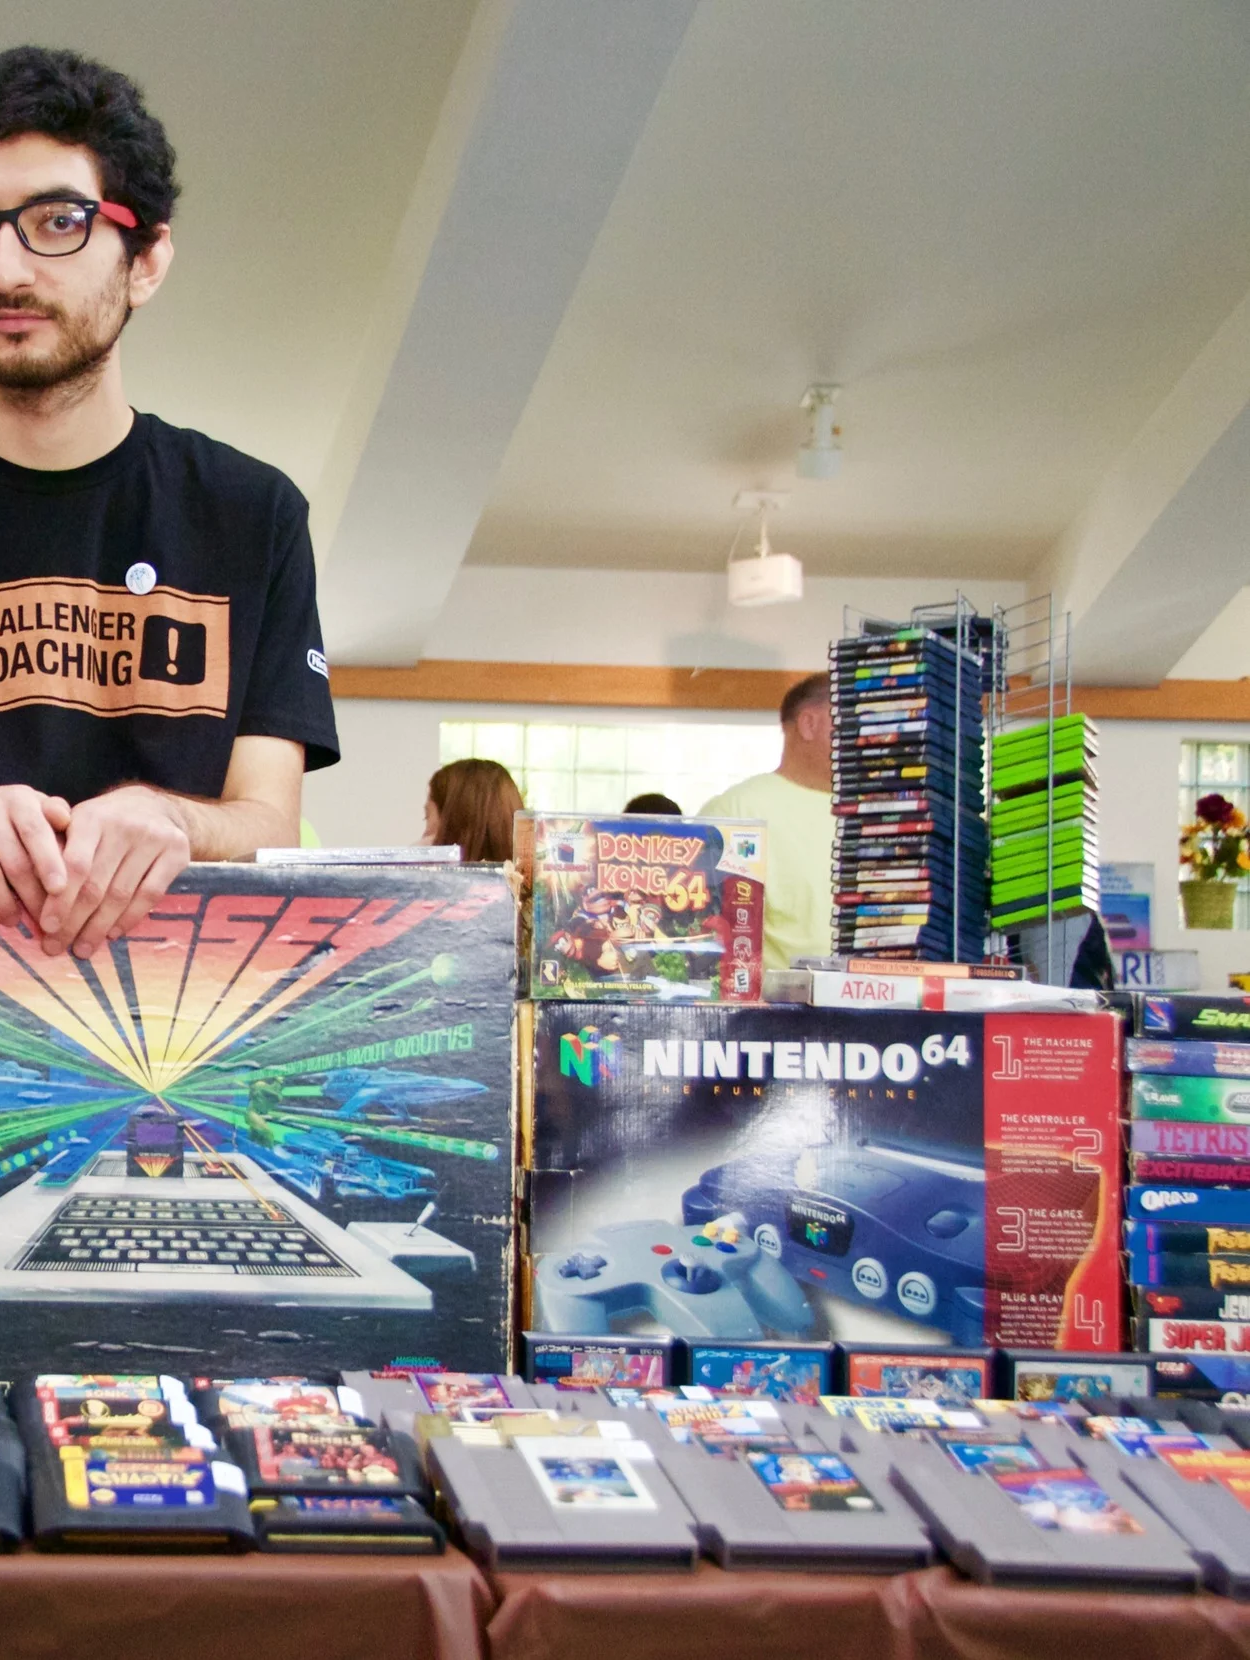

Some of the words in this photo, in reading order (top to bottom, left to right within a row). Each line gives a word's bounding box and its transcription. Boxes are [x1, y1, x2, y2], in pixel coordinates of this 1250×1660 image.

[597, 832, 705, 867] DONKEY
[597, 863, 668, 895] KONG
[664, 871, 708, 912] 64
[1117, 952, 1151, 985] RI
[840, 980, 895, 1001] ATARI
[643, 1039, 919, 1081] NINTENDO
[921, 1034, 970, 1066] 64
[992, 1035, 1021, 1080] 1
[1023, 1037, 1042, 1047] THE
[1045, 1038, 1093, 1048] MACHINE
[714, 1085, 762, 1097] FUN
[786, 1086, 916, 1100] MCHINE
[1000, 1114, 1019, 1123] THE
[1022, 1114, 1085, 1125] CONTROLLER
[1073, 1128, 1102, 1173] 2
[1154, 1121, 1247, 1155] TETRIS
[1136, 1161, 1250, 1182] EXCITEBIKE
[791, 1203, 836, 1224] NINTENDO
[996, 1206, 1025, 1252] 3
[1028, 1208, 1047, 1218] THE
[1049, 1209, 1084, 1219] GAMES
[1000, 1292, 1026, 1303] PLUG
[1030, 1293, 1036, 1303] &
[1039, 1293, 1064, 1304] PLAY
[1074, 1293, 1105, 1345] 4
[1219, 1294, 1250, 1319] JEO
[1162, 1321, 1225, 1351] SUPER
